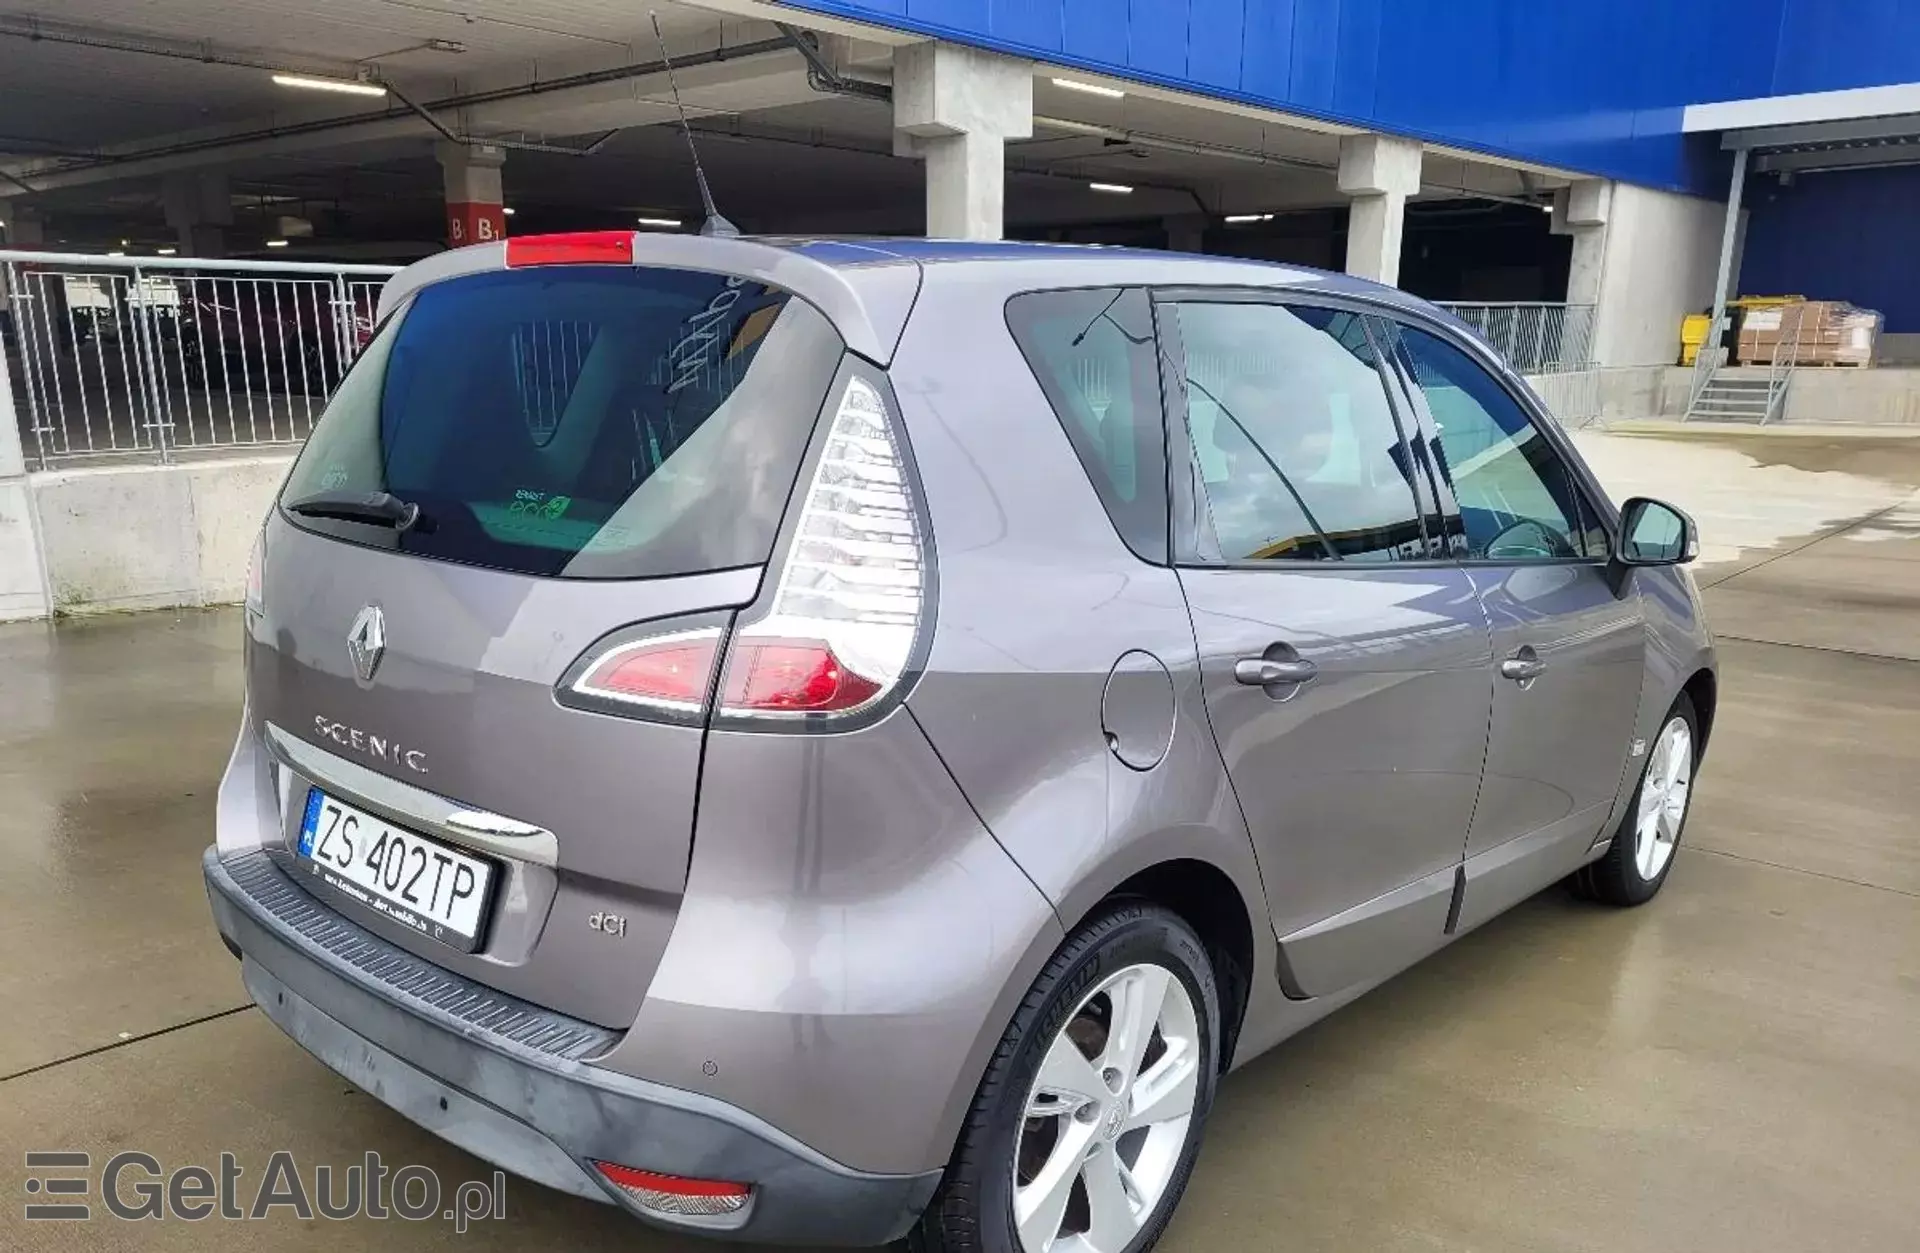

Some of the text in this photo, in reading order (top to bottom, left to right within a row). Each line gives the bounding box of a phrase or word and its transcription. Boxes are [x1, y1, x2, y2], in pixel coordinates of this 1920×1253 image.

[314, 714, 429, 774] SCENIC
[316, 804, 360, 869] ZS
[366, 830, 475, 920] 402TP
[588, 911, 626, 938] dCi
